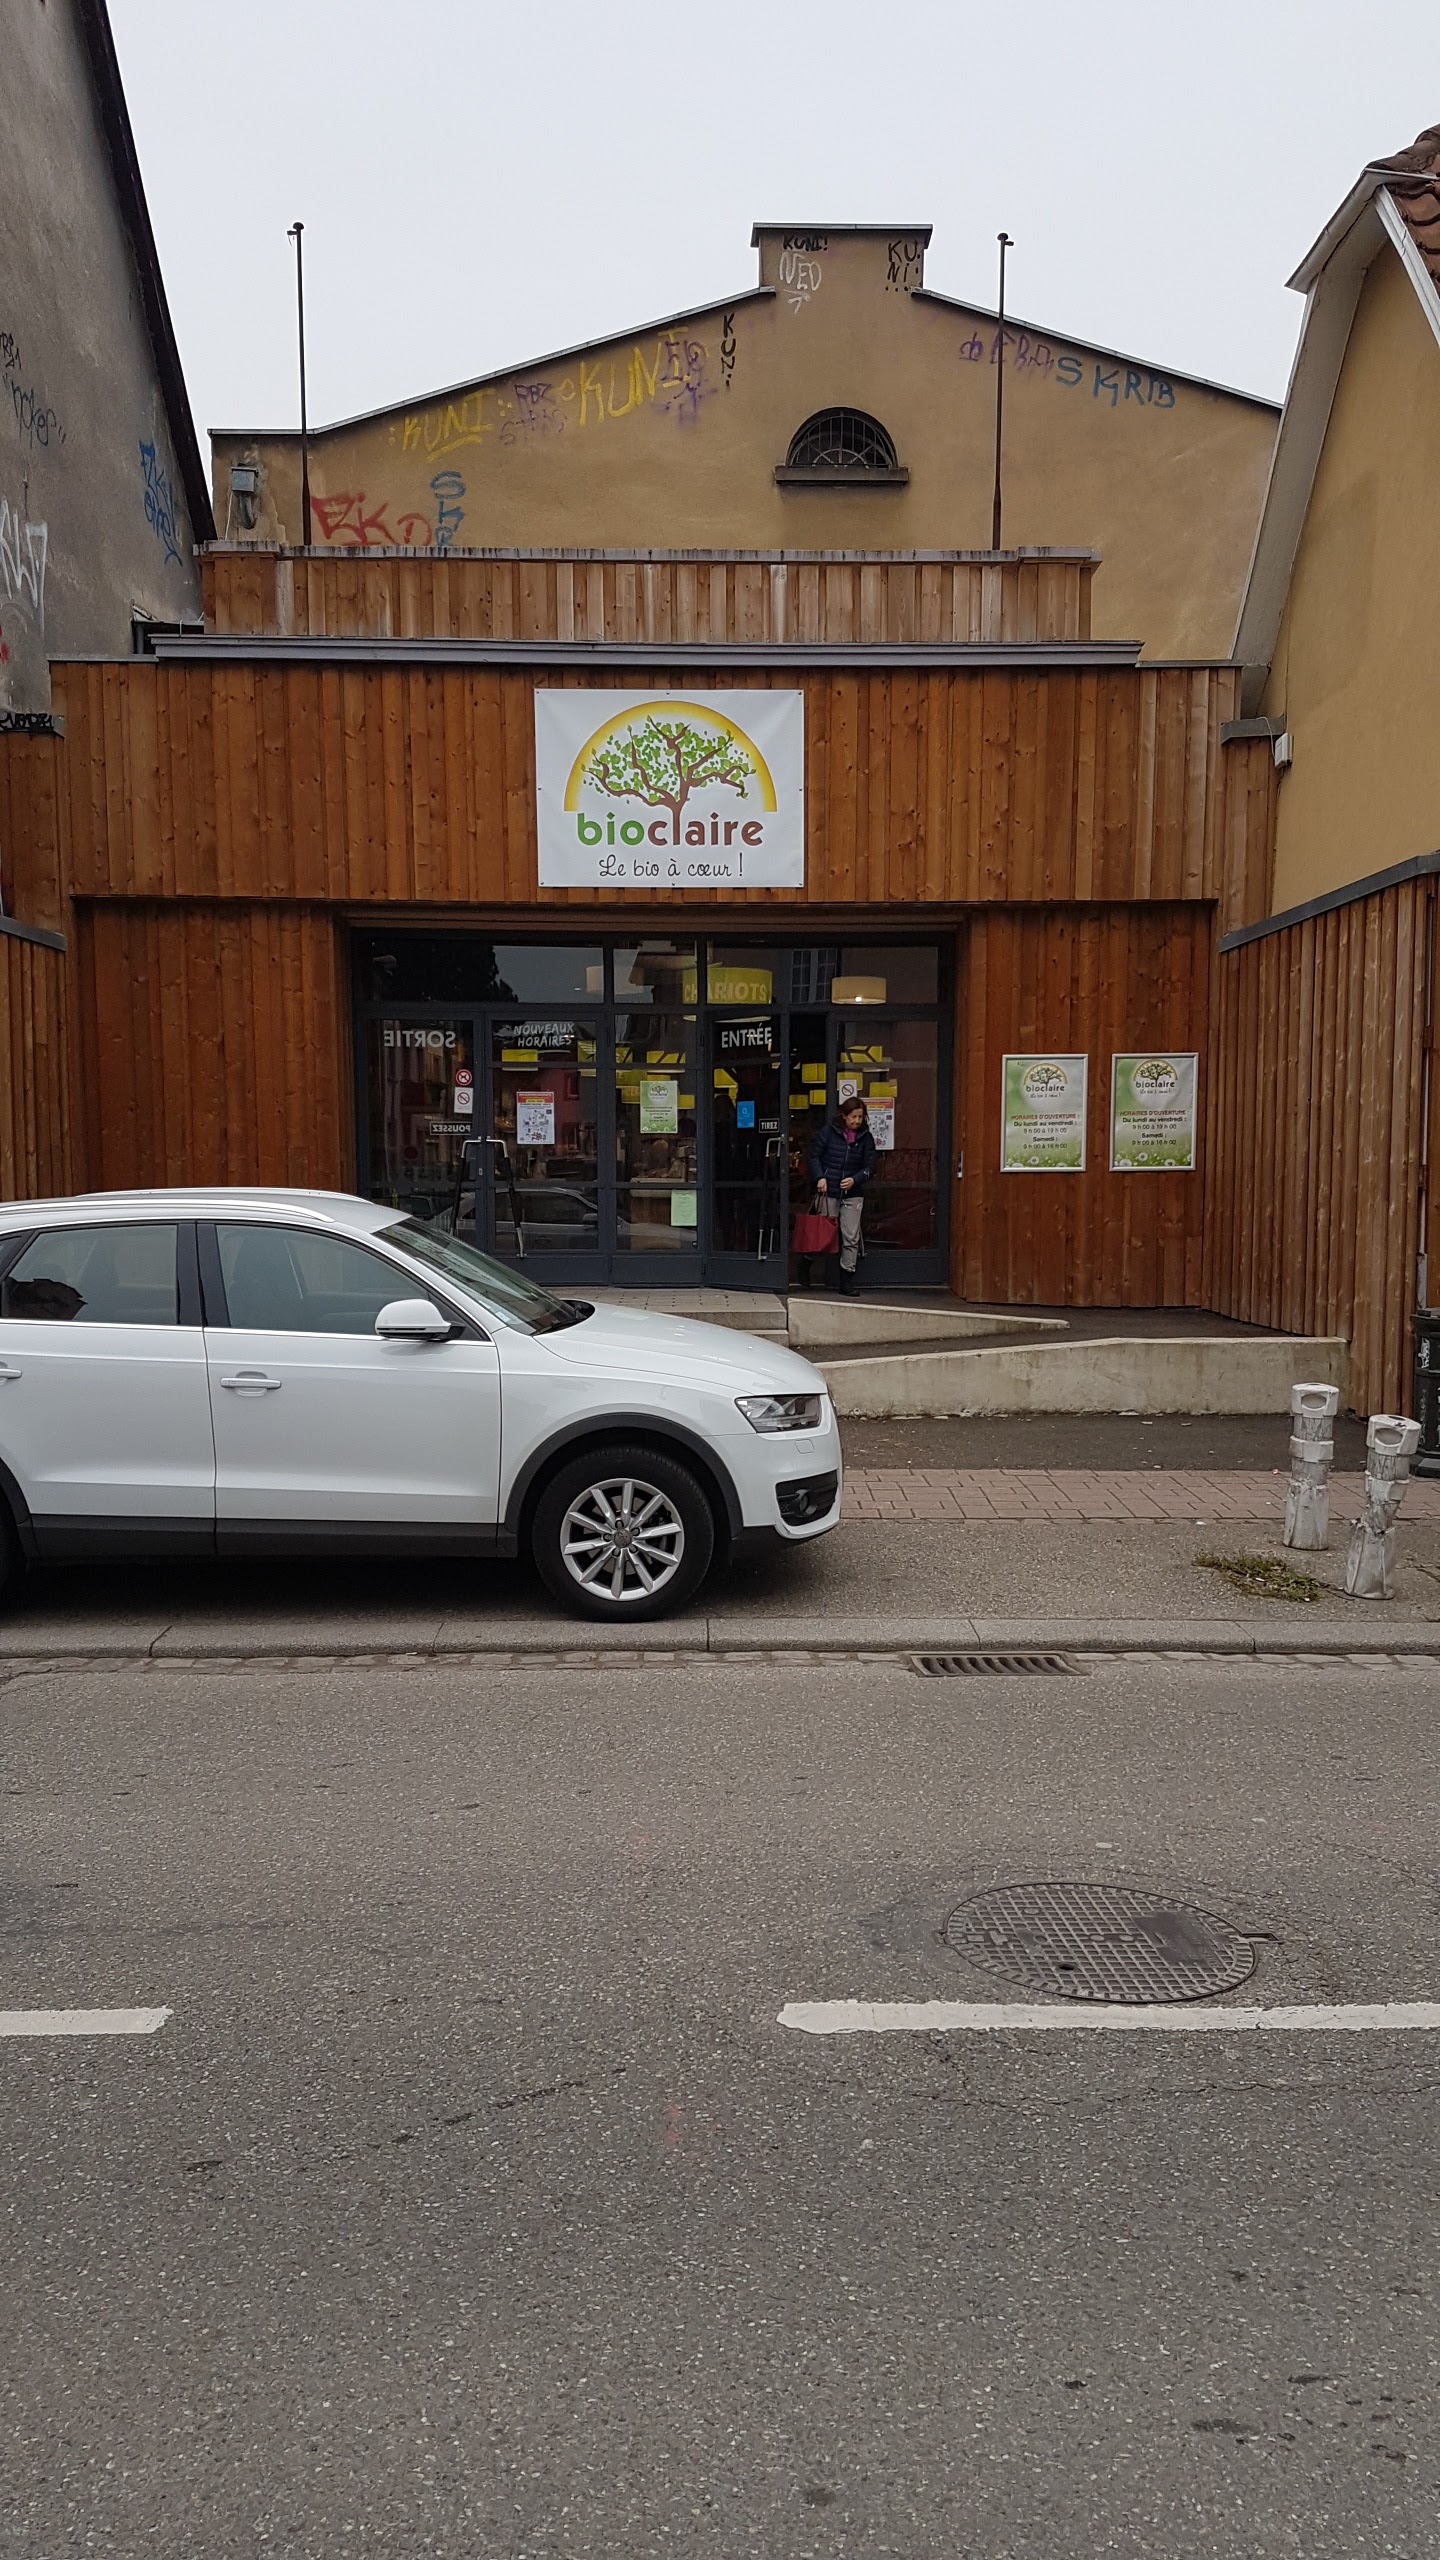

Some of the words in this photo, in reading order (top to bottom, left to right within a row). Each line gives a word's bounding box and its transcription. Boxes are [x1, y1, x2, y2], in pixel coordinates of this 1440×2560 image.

[577, 812, 764, 846] bioclaire
[599, 854, 626, 877] Le
[633, 859, 660, 877] bio
[668, 858, 680, 877] à
[687, 863, 732, 877] cœur
[514, 1023, 574, 1035] NOUVEAUX
[721, 1022, 772, 1048] ENTRÉE
[518, 1036, 572, 1047] HORAIRES
